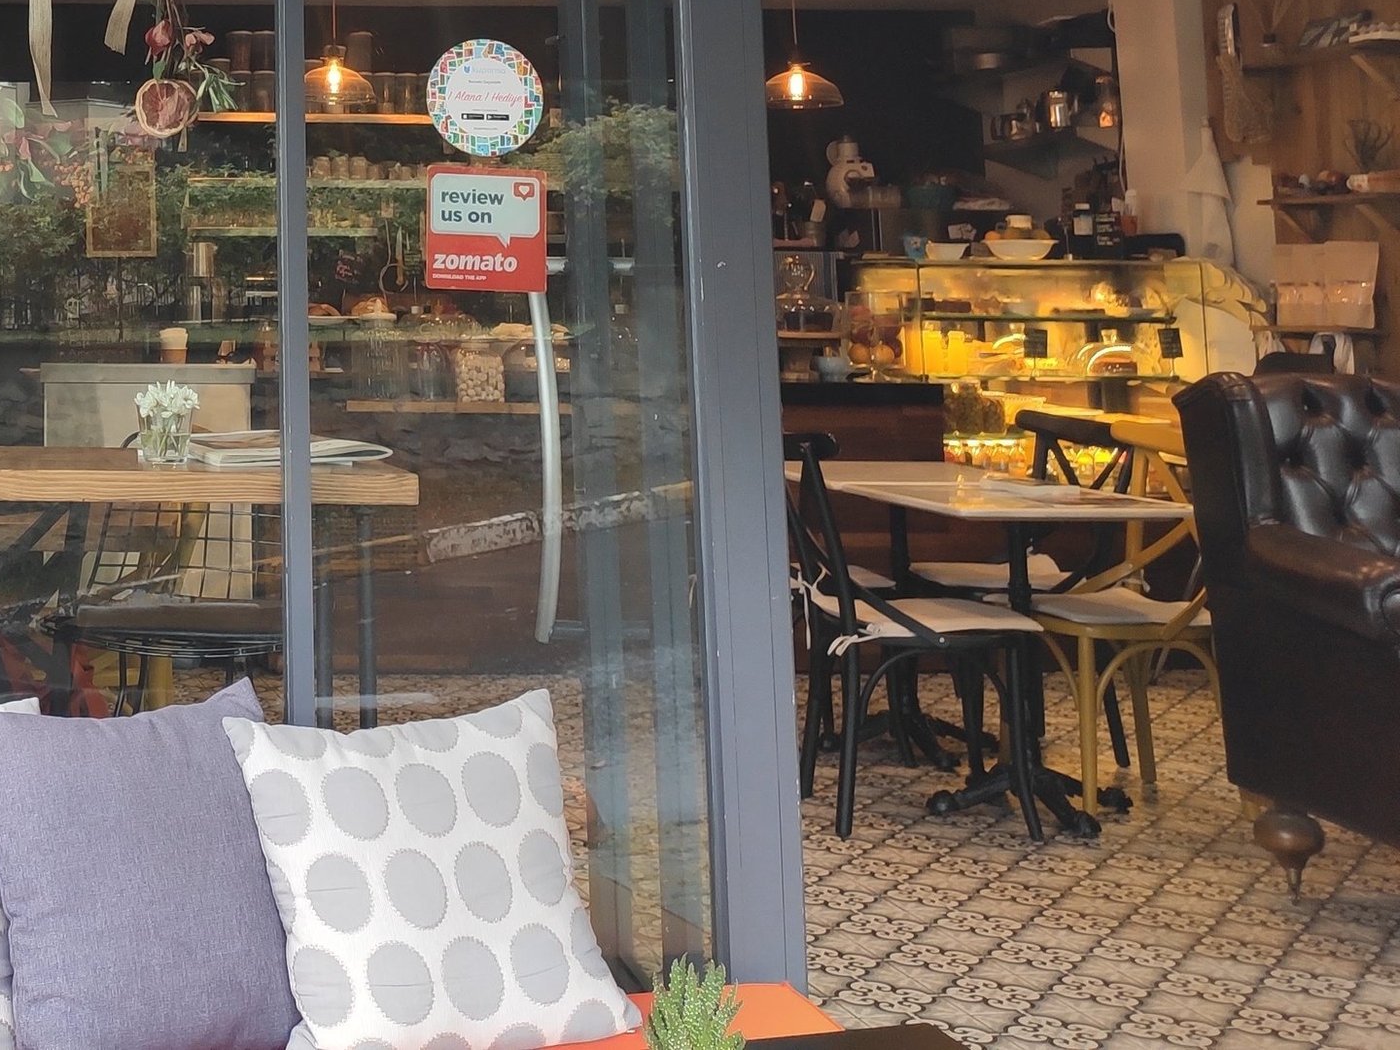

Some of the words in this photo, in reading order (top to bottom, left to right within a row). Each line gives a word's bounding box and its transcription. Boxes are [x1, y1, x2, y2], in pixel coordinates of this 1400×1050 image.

[455, 91, 482, 102] Alana
[492, 92, 522, 107] Hediye
[441, 189, 504, 205] review
[441, 209, 463, 222] us
[468, 210, 492, 223] on
[432, 253, 518, 272] zomato
